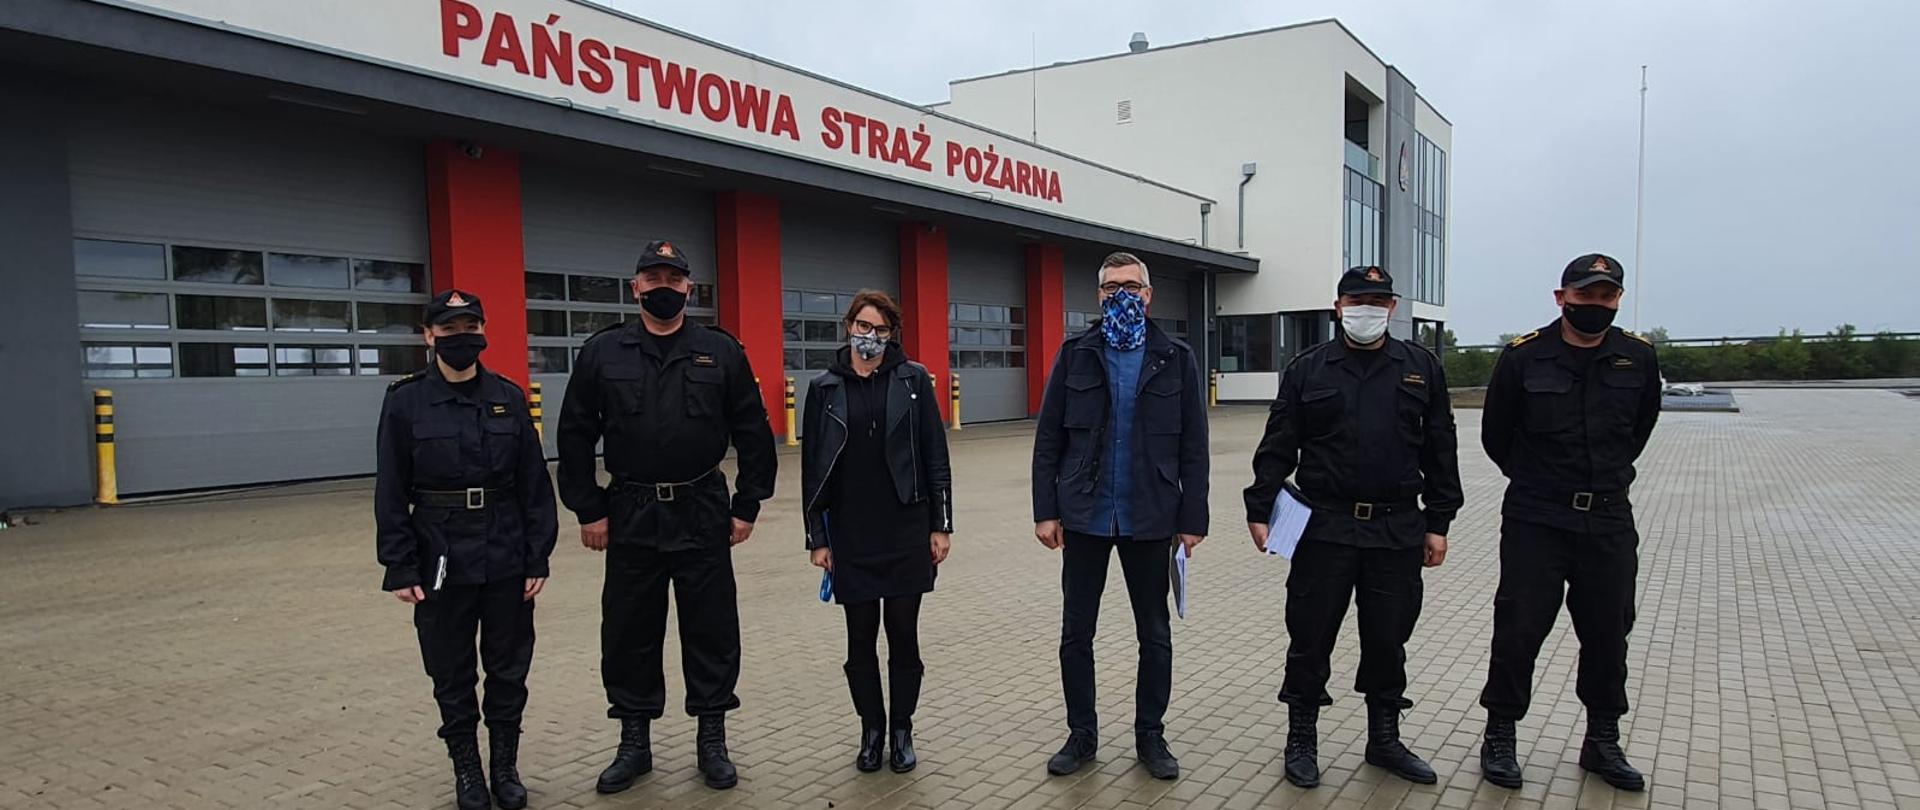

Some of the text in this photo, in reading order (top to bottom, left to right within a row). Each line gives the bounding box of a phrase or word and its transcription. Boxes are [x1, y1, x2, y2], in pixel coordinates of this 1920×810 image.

[441, 0, 1063, 203] PAŃSTWOWA STRAŻ POŻARNA
